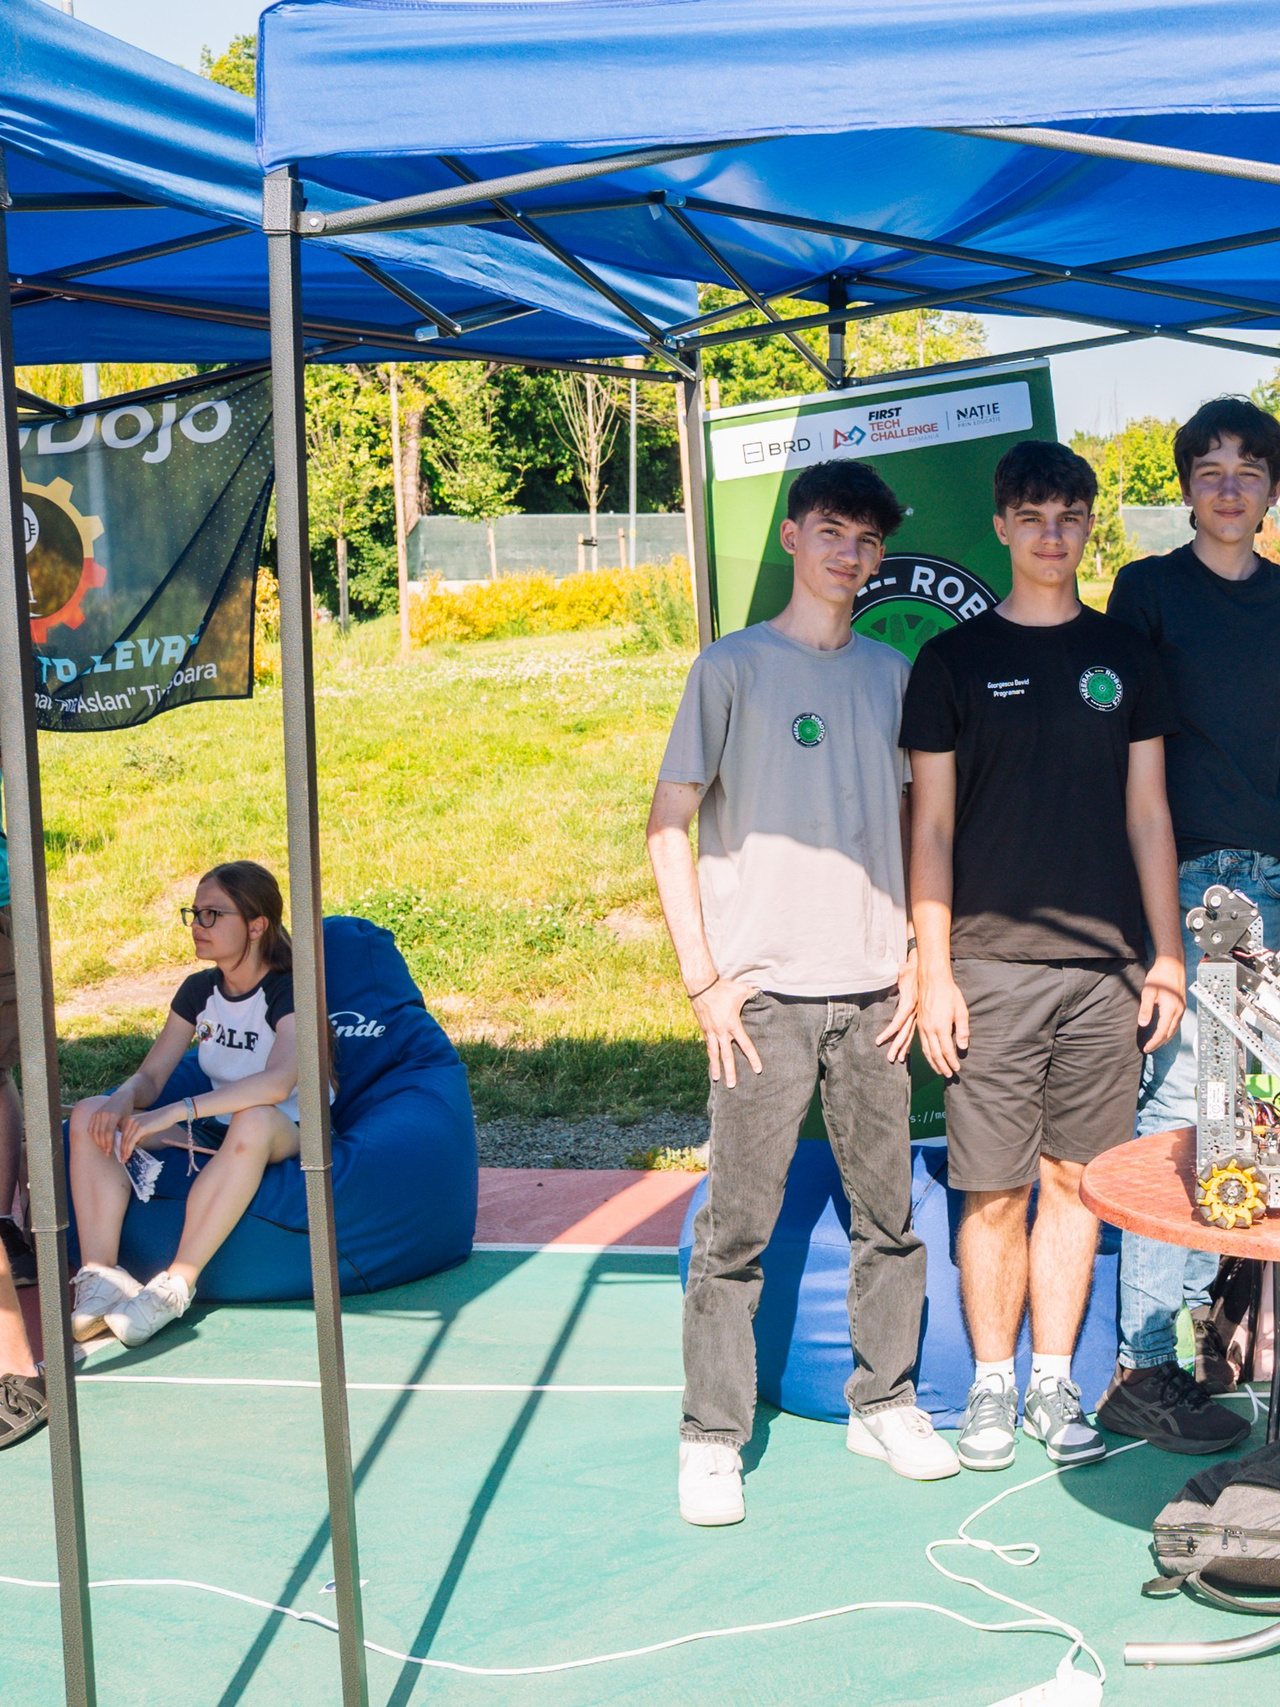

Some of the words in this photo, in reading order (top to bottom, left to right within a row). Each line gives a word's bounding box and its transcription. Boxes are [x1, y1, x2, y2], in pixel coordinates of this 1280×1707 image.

[868, 407, 902, 421] FIRST
[869, 419, 900, 431] TECH
[870, 423, 939, 442] CHALLENGE
[768, 438, 811, 456] BRD
[910, 565, 988, 620] ROB
[909, 1110, 947, 1123] s://me
